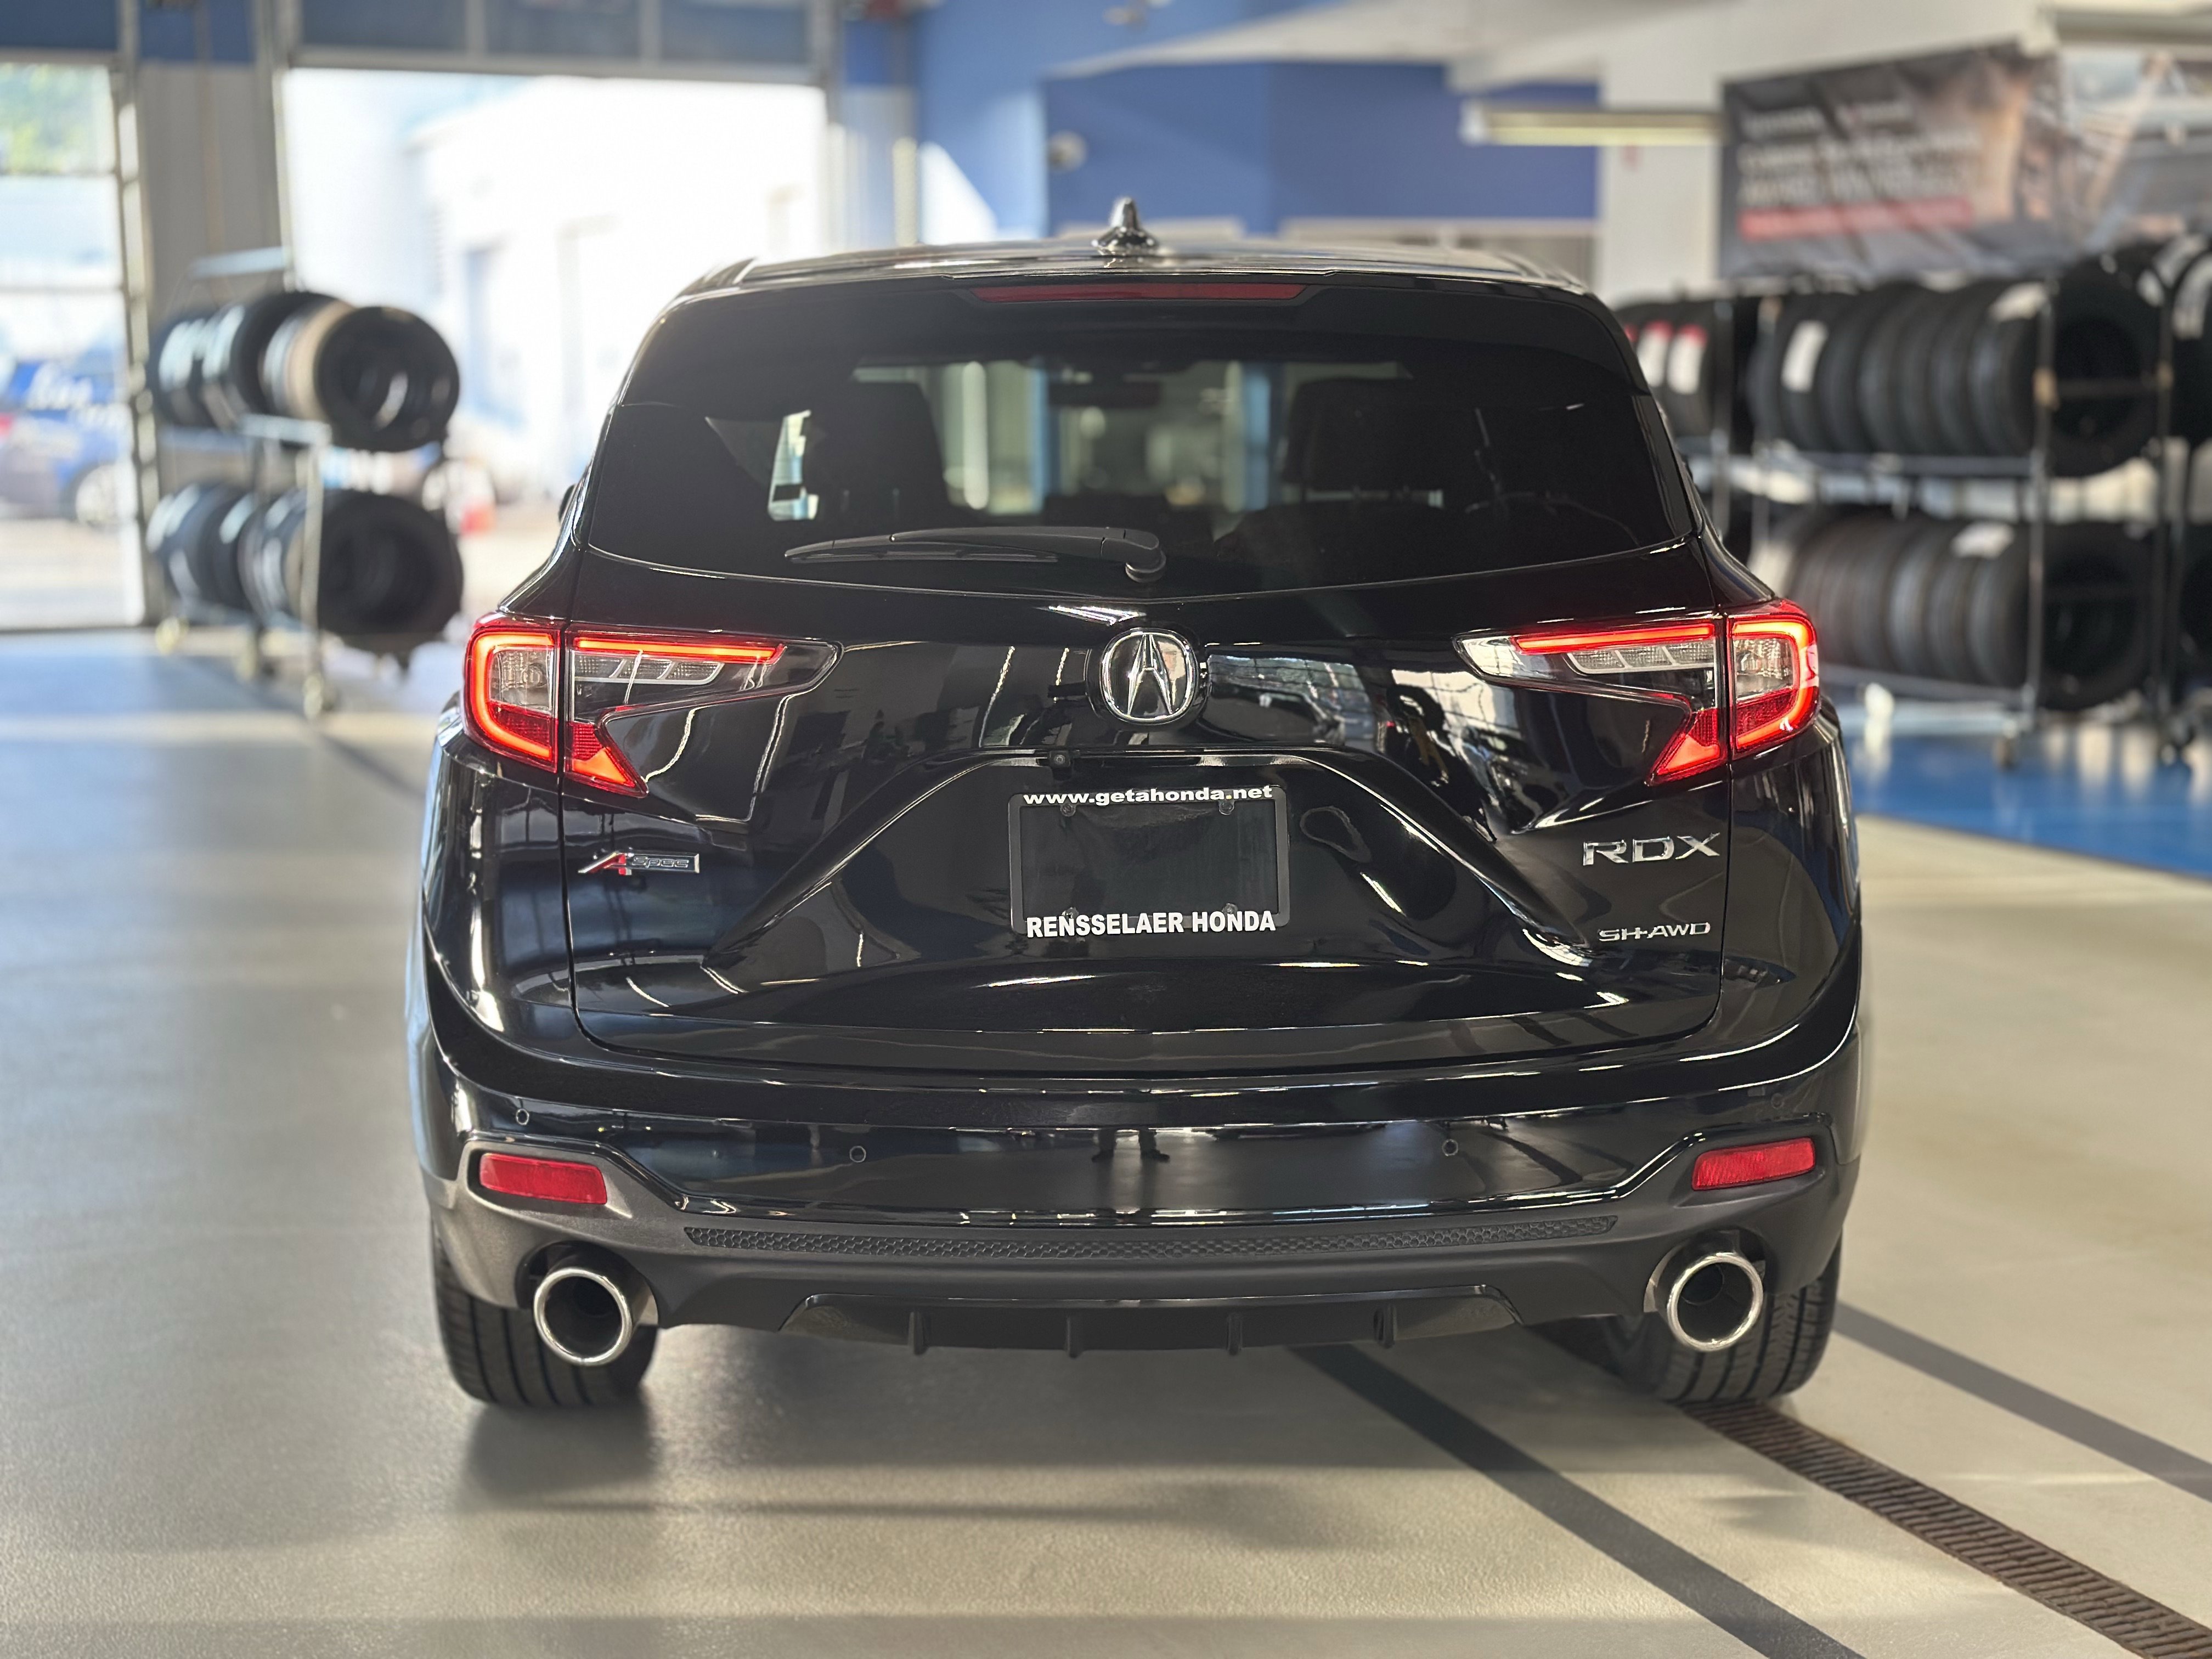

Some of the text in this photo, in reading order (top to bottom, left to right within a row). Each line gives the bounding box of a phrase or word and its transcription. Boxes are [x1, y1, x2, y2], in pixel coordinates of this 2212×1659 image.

[1023, 785, 1273, 805] www.getahonda.net
[1582, 832, 1720, 866] RDX
[1026, 910, 1276, 938] RENSSELAER HONDA
[1598, 922, 1711, 942] SH-AWD
